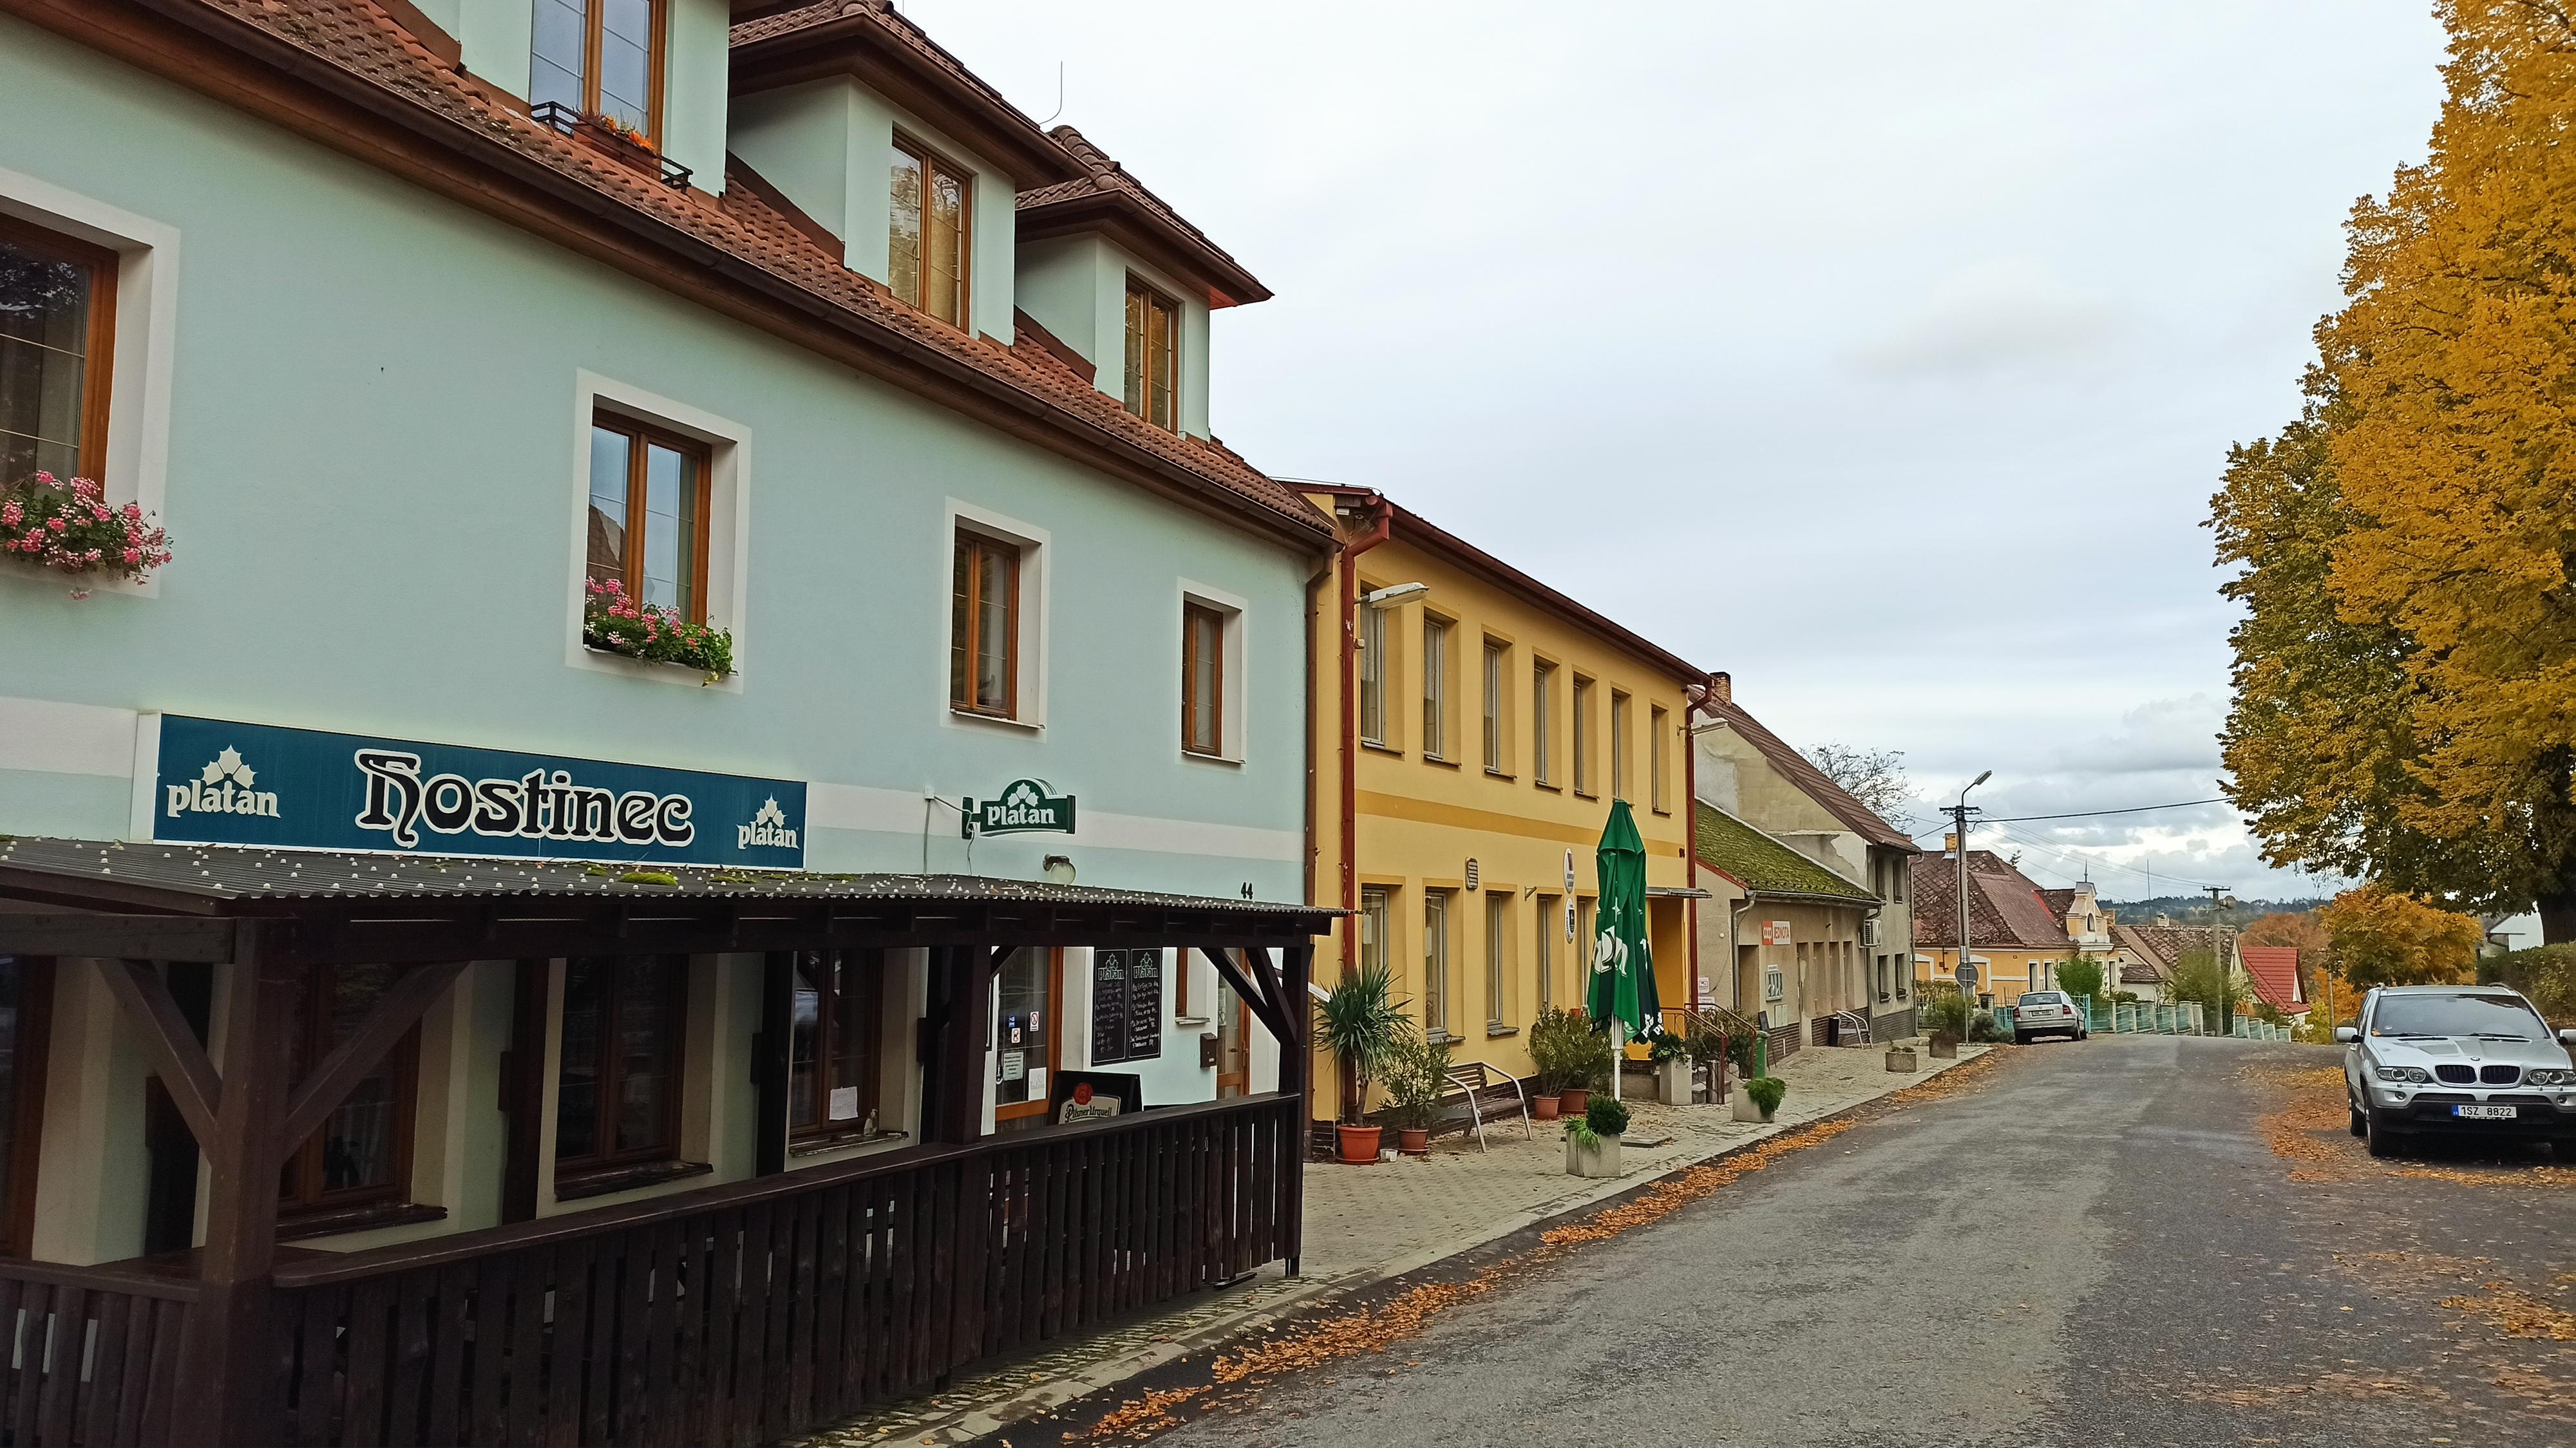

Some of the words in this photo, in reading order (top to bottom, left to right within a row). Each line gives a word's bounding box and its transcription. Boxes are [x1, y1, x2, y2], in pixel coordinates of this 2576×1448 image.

[166, 778, 281, 818] platan
[355, 748, 694, 849] Hostinec
[987, 804, 1056, 825] Platan
[736, 820, 800, 849] platan
[1241, 882, 1253, 899] 44
[1097, 967, 1124, 981] Platan
[1133, 966, 1159, 979] Platan
[1065, 1104, 1089, 1123] Pilsner
[1089, 1105, 1113, 1118] Urquell
[2461, 1107, 2479, 1116] 1SZ
[2486, 1107, 2512, 1116] 8822
